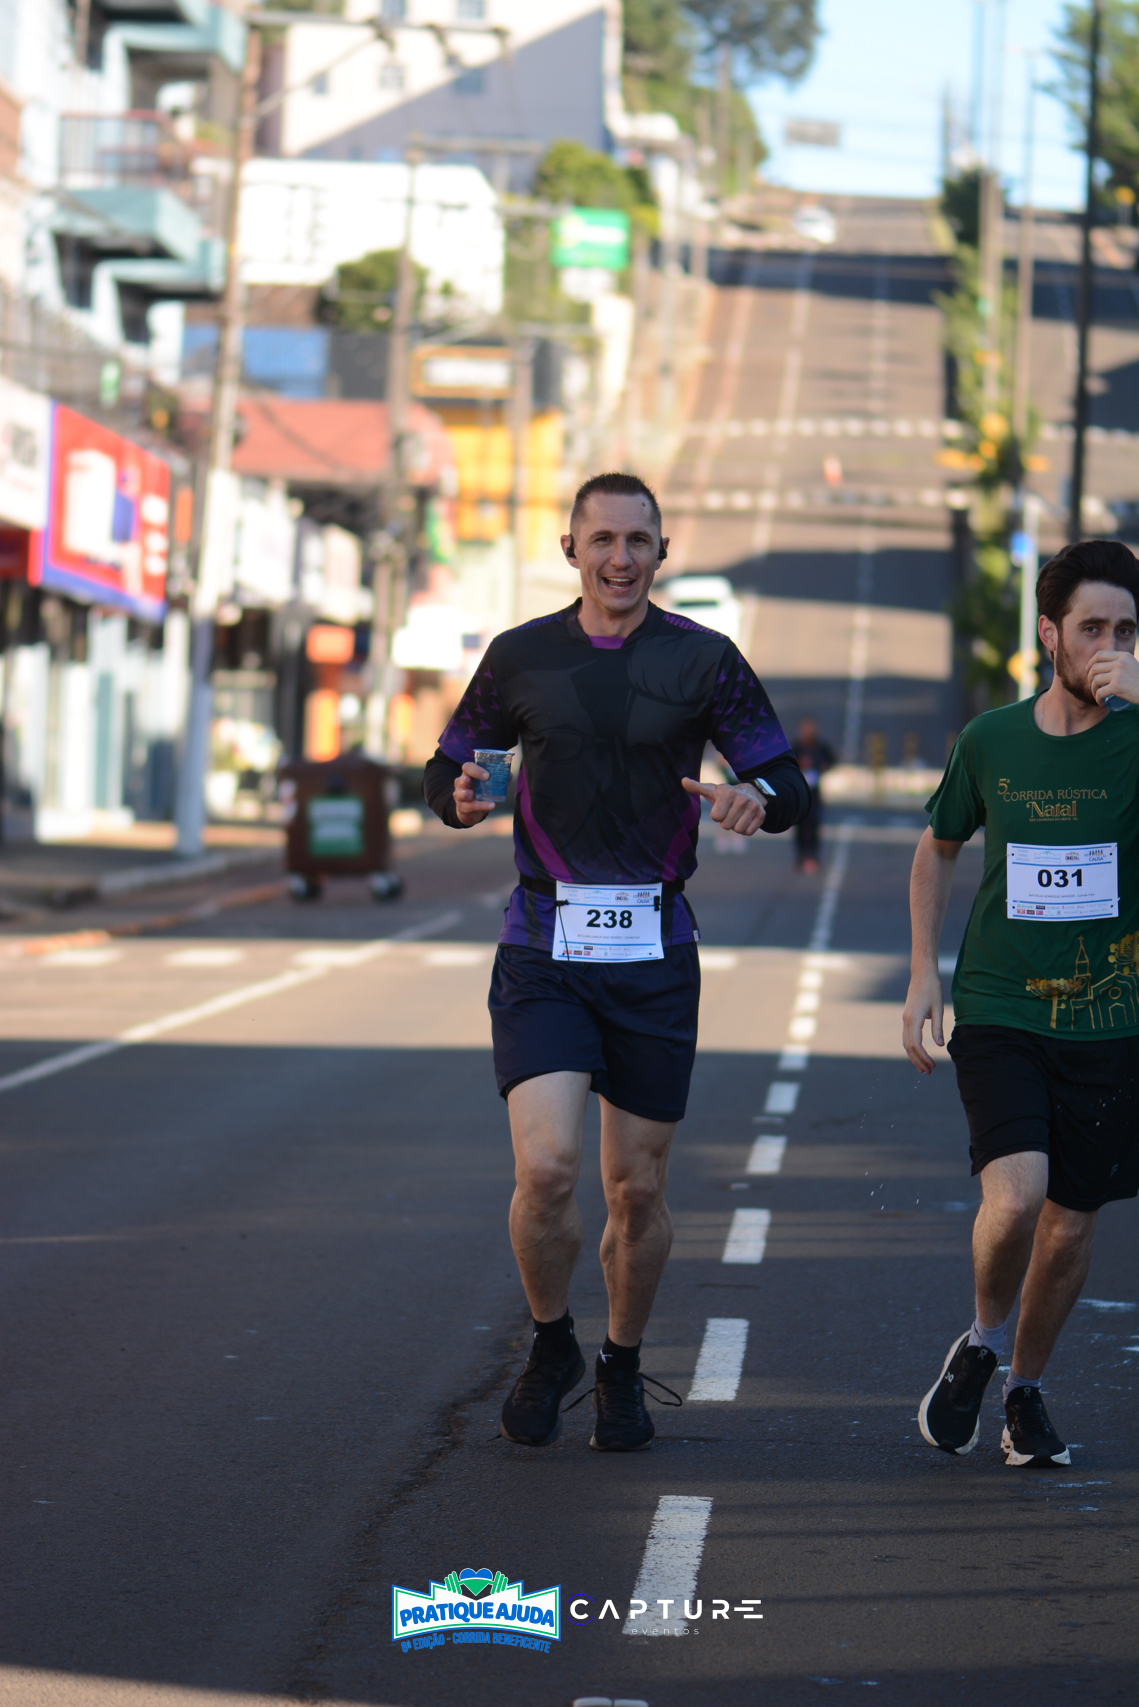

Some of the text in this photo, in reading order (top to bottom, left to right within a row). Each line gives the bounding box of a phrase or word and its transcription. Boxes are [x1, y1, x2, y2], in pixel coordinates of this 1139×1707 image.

[1003, 787, 1108, 802] CORRIDA RÚSTICA
[1026, 800, 1077, 818] Natal
[1037, 868, 1083, 888] 031
[586, 909, 633, 929] 238
